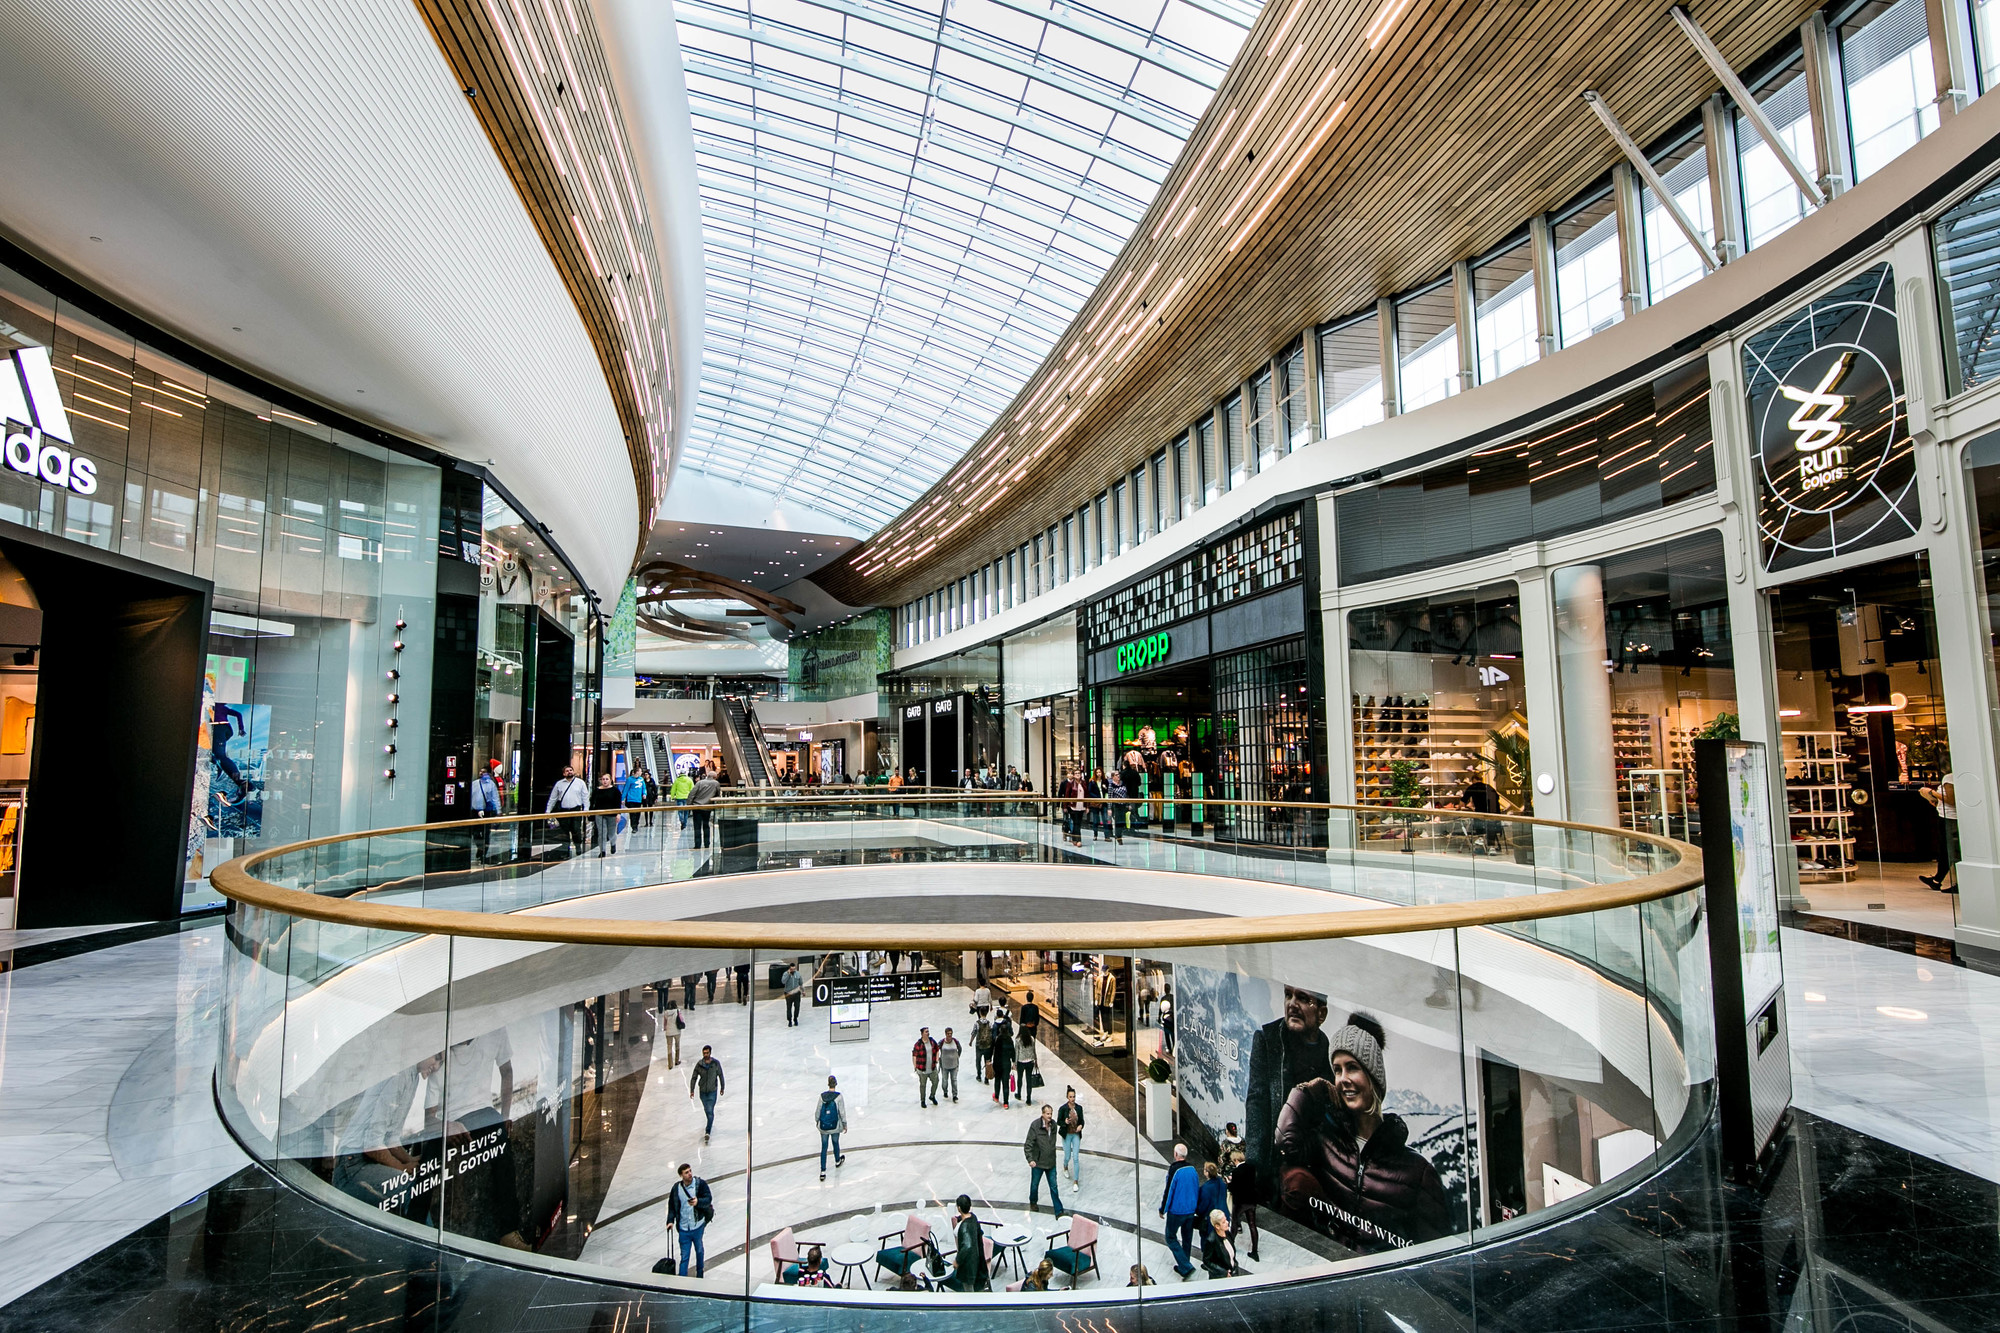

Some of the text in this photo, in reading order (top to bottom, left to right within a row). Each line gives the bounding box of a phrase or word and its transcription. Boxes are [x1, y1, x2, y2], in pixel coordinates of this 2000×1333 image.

[1802, 467, 1843, 490] colors
[1117, 631, 1169, 672] CROPP
[816, 984, 829, 1002] 0
[1182, 1012, 1239, 1061] LAVARD
[381, 1168, 417, 1195] TWÓJ
[419, 1147, 458, 1177] SKLP
[410, 1168, 454, 1199] NIEML
[458, 1142, 507, 1175] GOTOWY
